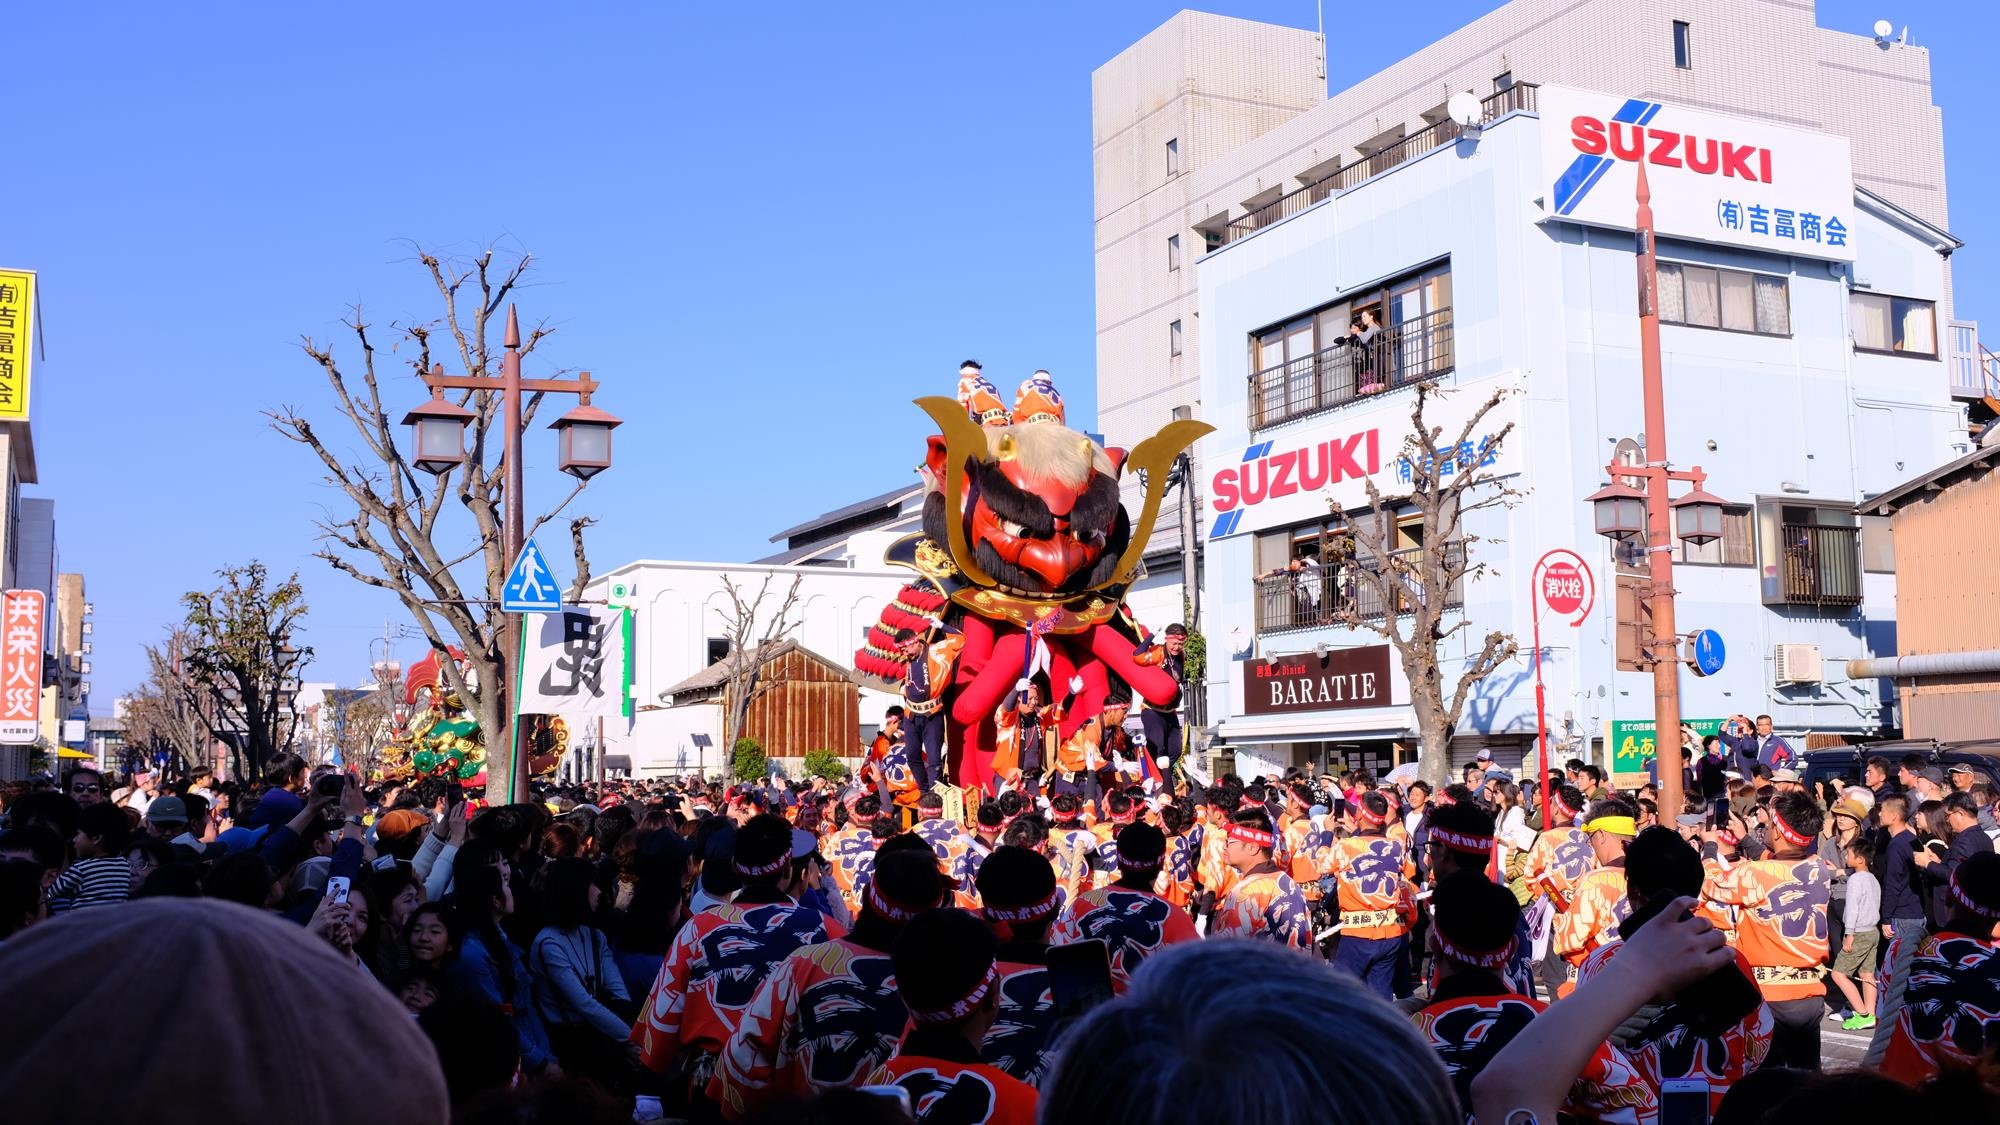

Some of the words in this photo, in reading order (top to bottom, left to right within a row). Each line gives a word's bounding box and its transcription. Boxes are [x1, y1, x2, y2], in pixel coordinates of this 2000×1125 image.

[1570, 115, 1773, 184] SUZUKI
[1212, 428, 1380, 512] SUZUKI
[1545, 577, 1582, 599] 消火栓
[4, 595, 39, 718] 共栄火災
[1270, 672, 1377, 706] BARATIE
